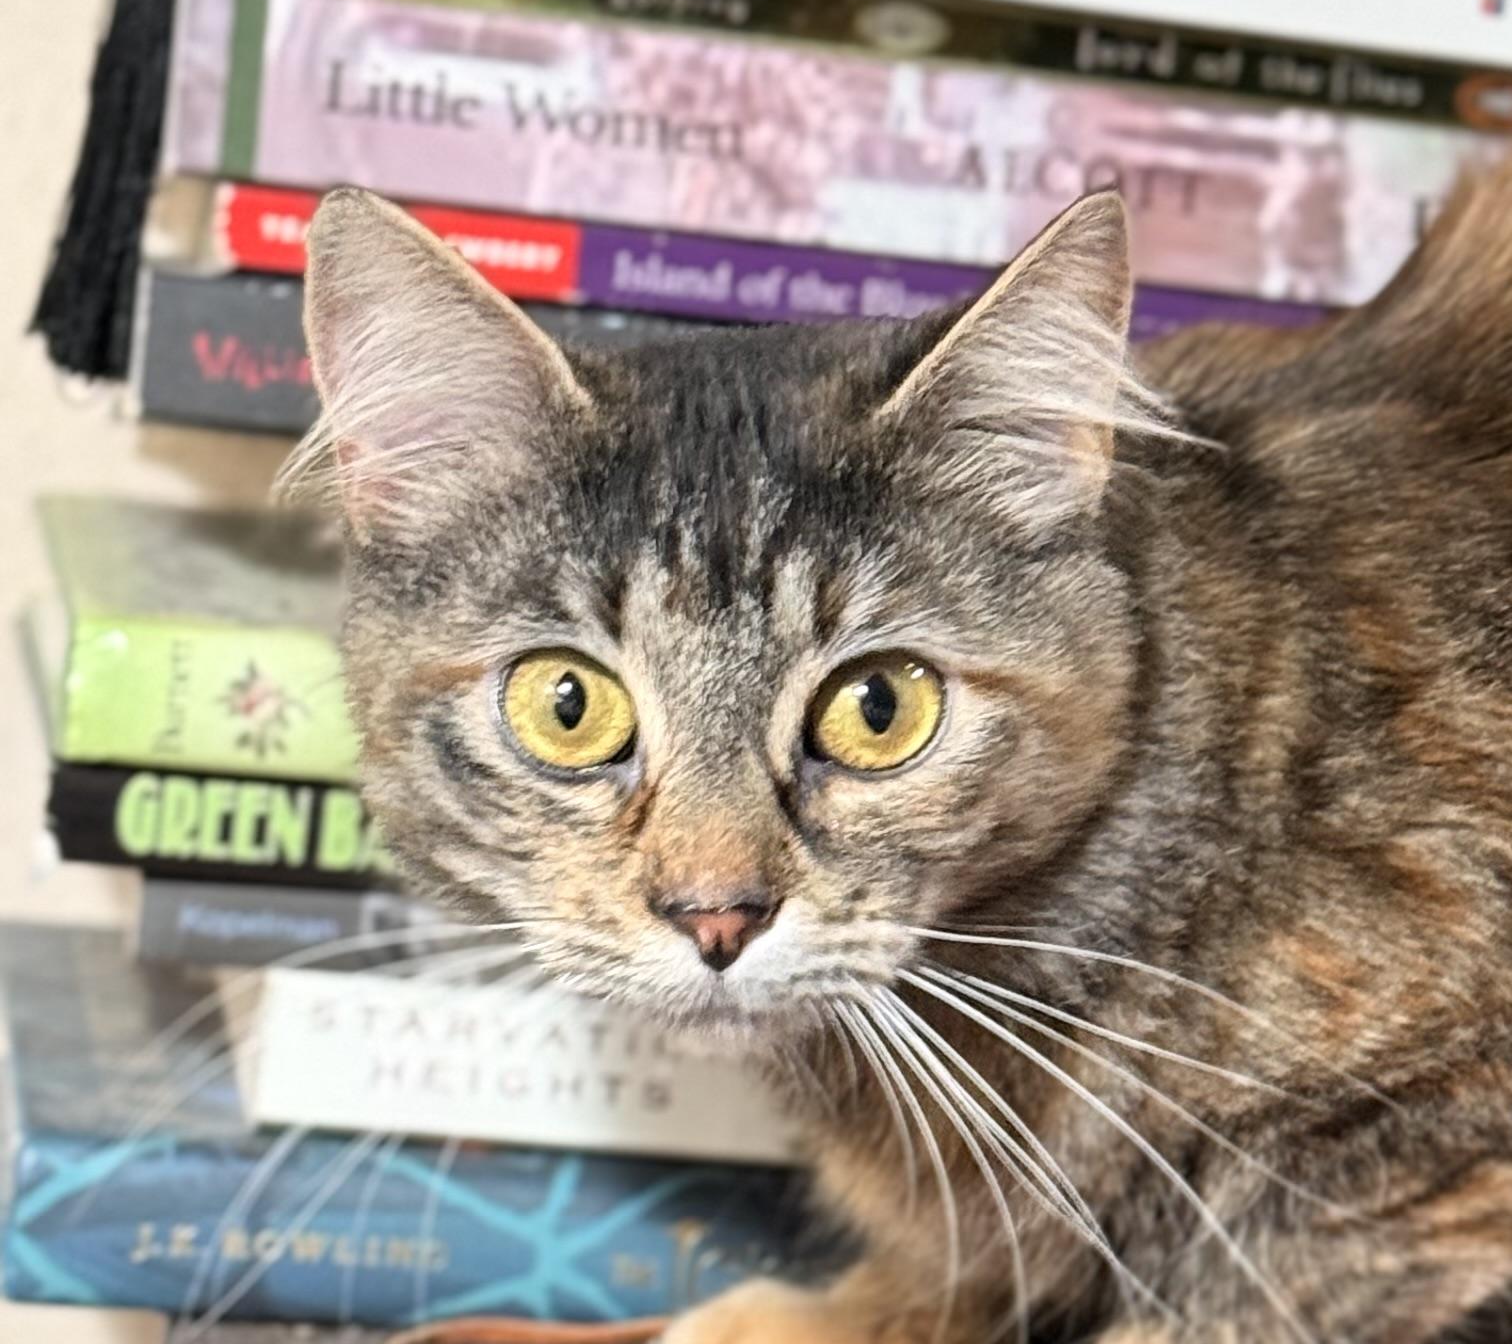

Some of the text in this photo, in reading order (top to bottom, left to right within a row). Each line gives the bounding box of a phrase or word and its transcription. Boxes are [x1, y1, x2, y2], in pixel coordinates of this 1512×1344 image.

[324, 61, 747, 158] Little Women
[115, 771, 313, 867] GREEN
